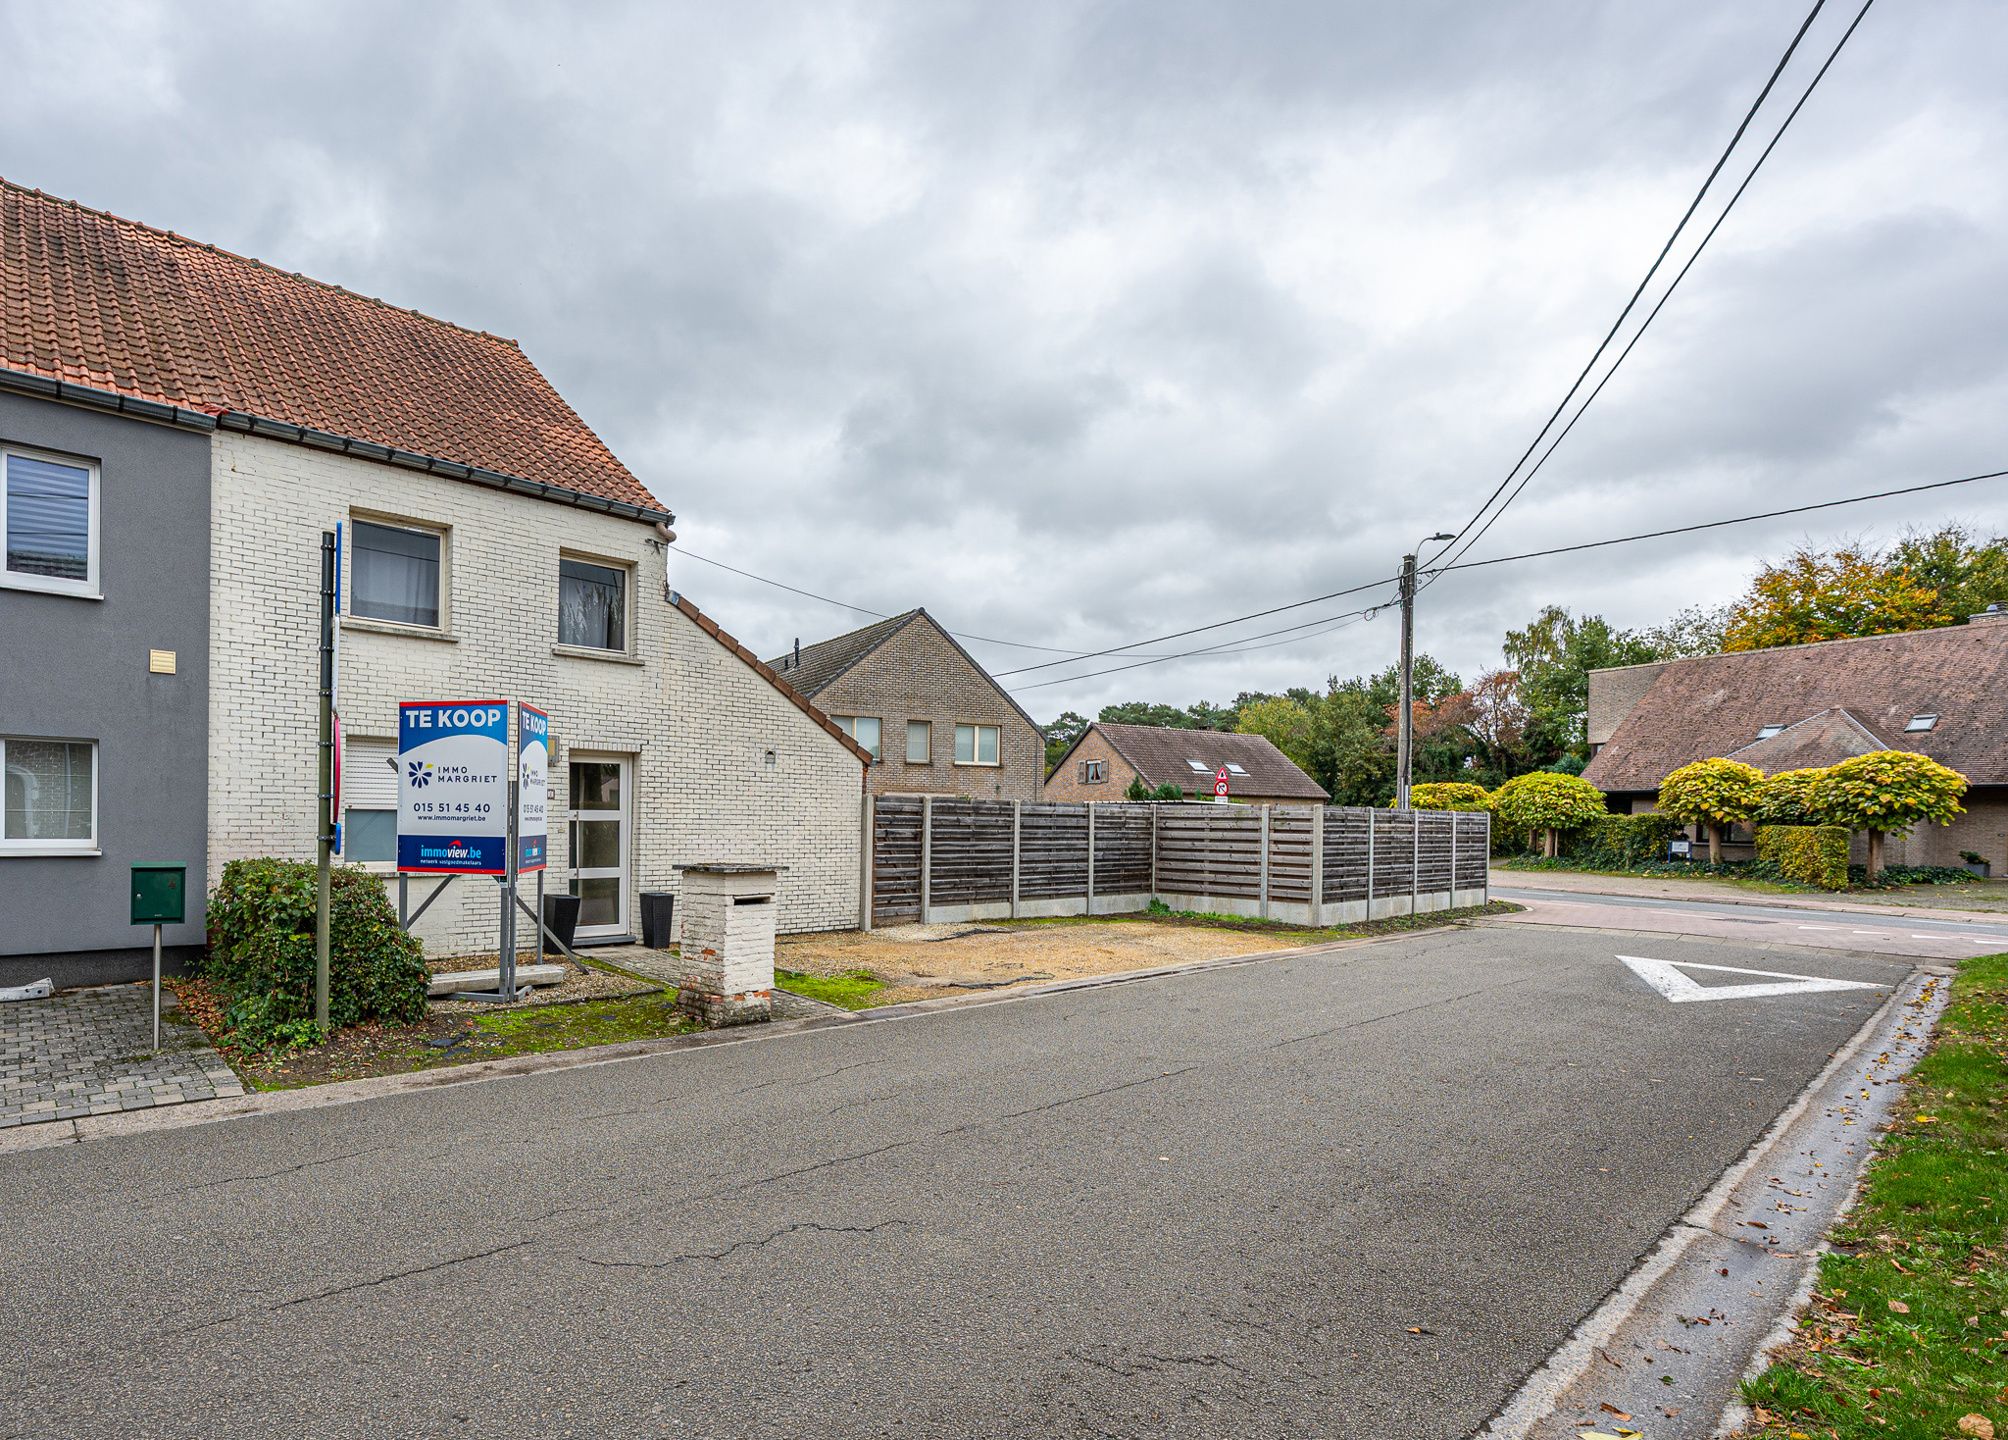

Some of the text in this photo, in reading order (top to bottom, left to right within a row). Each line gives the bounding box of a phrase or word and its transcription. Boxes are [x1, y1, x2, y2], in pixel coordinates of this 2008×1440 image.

[405, 708, 501, 728] TE KOOP
[522, 711, 547, 736] TE KOOP
[437, 766, 468, 774] IMMO
[437, 775, 498, 783] MARGRIET
[413, 802, 491, 813] 015 51 45 40
[417, 814, 486, 822] www.immomargriet.be
[420, 844, 482, 859] immoview.be
